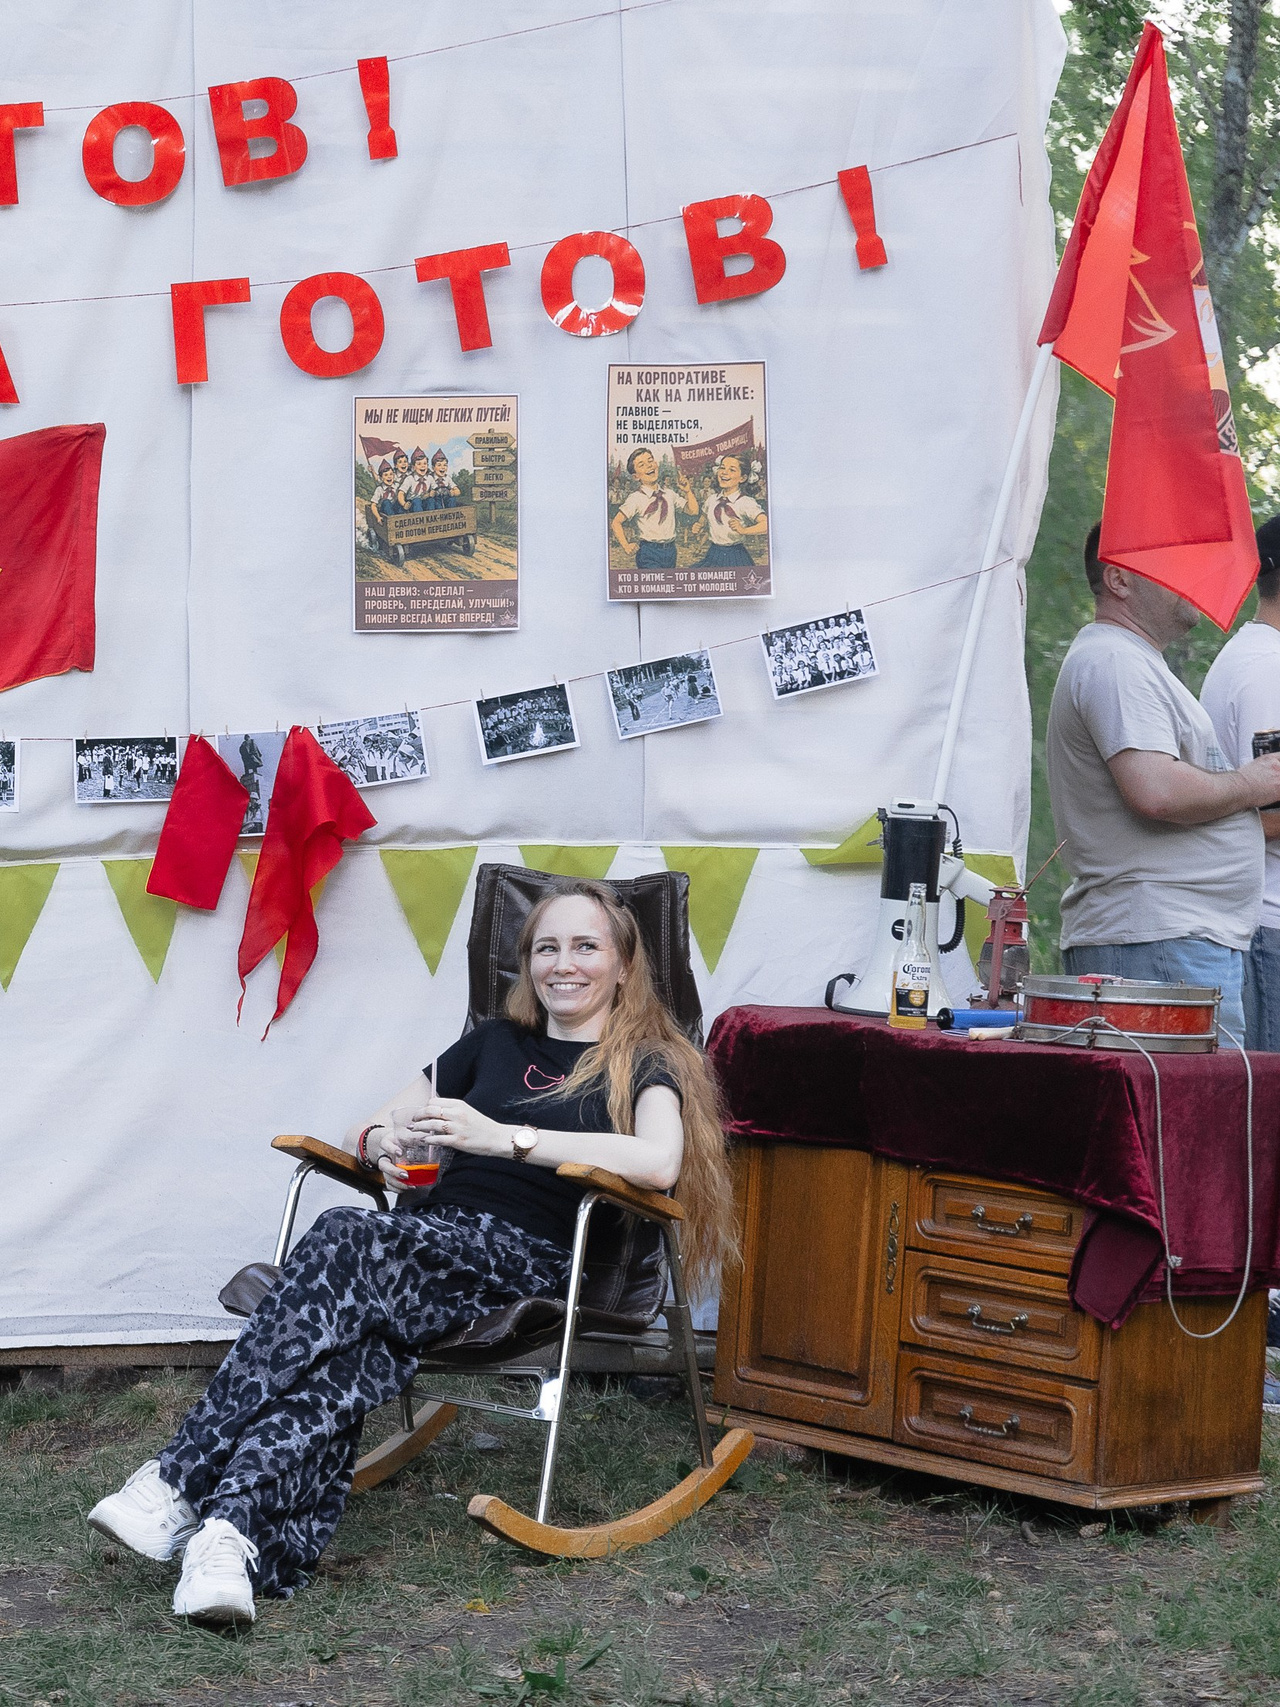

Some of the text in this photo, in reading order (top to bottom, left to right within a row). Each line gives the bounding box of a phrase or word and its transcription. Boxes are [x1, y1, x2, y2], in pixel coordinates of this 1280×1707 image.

[170, 165, 888, 385] ГОТОВ!
[617, 370, 726, 385] НА КОРПОРАТИВЕ
[636, 384, 754, 402] КАК НА ЛИНЕЙКЕ:
[364, 404, 511, 425] МЫ НЕ ИЩЕМ ЛЕГКИХ ПУТЕЙ!
[616, 406, 659, 416] ГЛАВНОЕ
[616, 419, 703, 431] НЕ ВЫДЕЛЯТЬСЯ,
[616, 433, 689, 444] НО ТАНЦЕВАТЬ!
[395, 516, 425, 528] СДЕЛАЕМ
[395, 521, 467, 539] НО ПОТОМ ПЕРЕДЕЛАЕМ
[618, 573, 632, 582] КТО
[633, 573, 639, 582] В
[641, 573, 665, 582] РИТМЕ
[675, 572, 688, 581] ТОТ
[690, 572, 696, 581] В
[698, 571, 736, 581] КОМАНДЕ!
[365, 587, 386, 597] НАШ
[388, 587, 420, 598] ДЕВИЗ:
[423, 586, 465, 597] «СДЕЛАЛ
[618, 585, 632, 593] КТО
[633, 585, 639, 593] В
[641, 584, 675, 594] КОМАНДЕ
[683, 583, 697, 592] ТОТ
[699, 582, 737, 593] МОЛОДЕЦ!
[365, 597, 515, 610] ПРОВЕРЬ, ПЕРЕДЕЛАЙ, УЛУЧШИ!»
[365, 612, 495, 624] ПИОНЕР ВСЕГДА ИДЕТ ВПЕРЕД!
